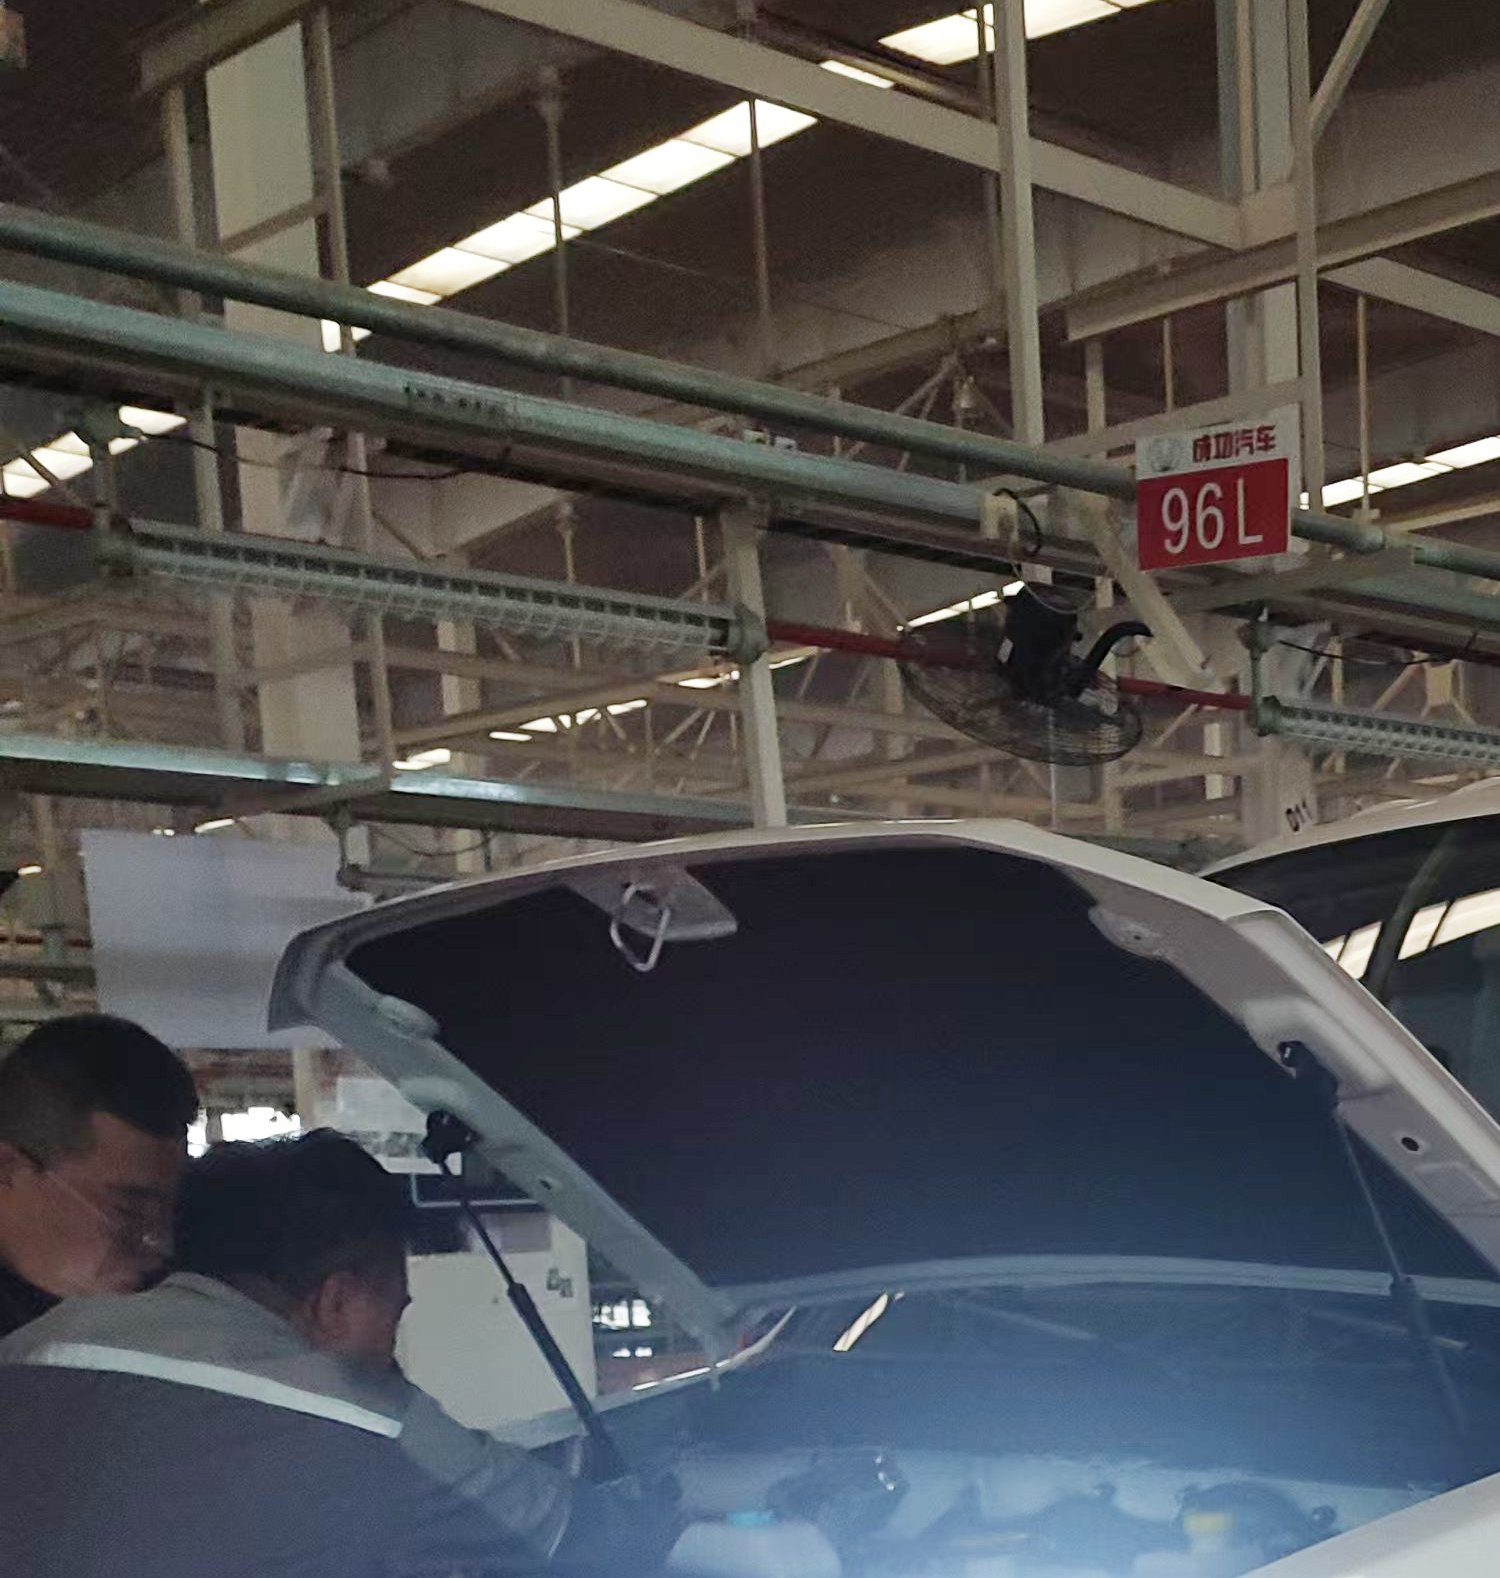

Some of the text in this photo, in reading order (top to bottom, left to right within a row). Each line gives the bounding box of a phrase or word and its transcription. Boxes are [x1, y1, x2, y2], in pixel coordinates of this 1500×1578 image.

[1193, 424, 1277, 463] 成功汽车
[1161, 476, 1264, 554] 96L
